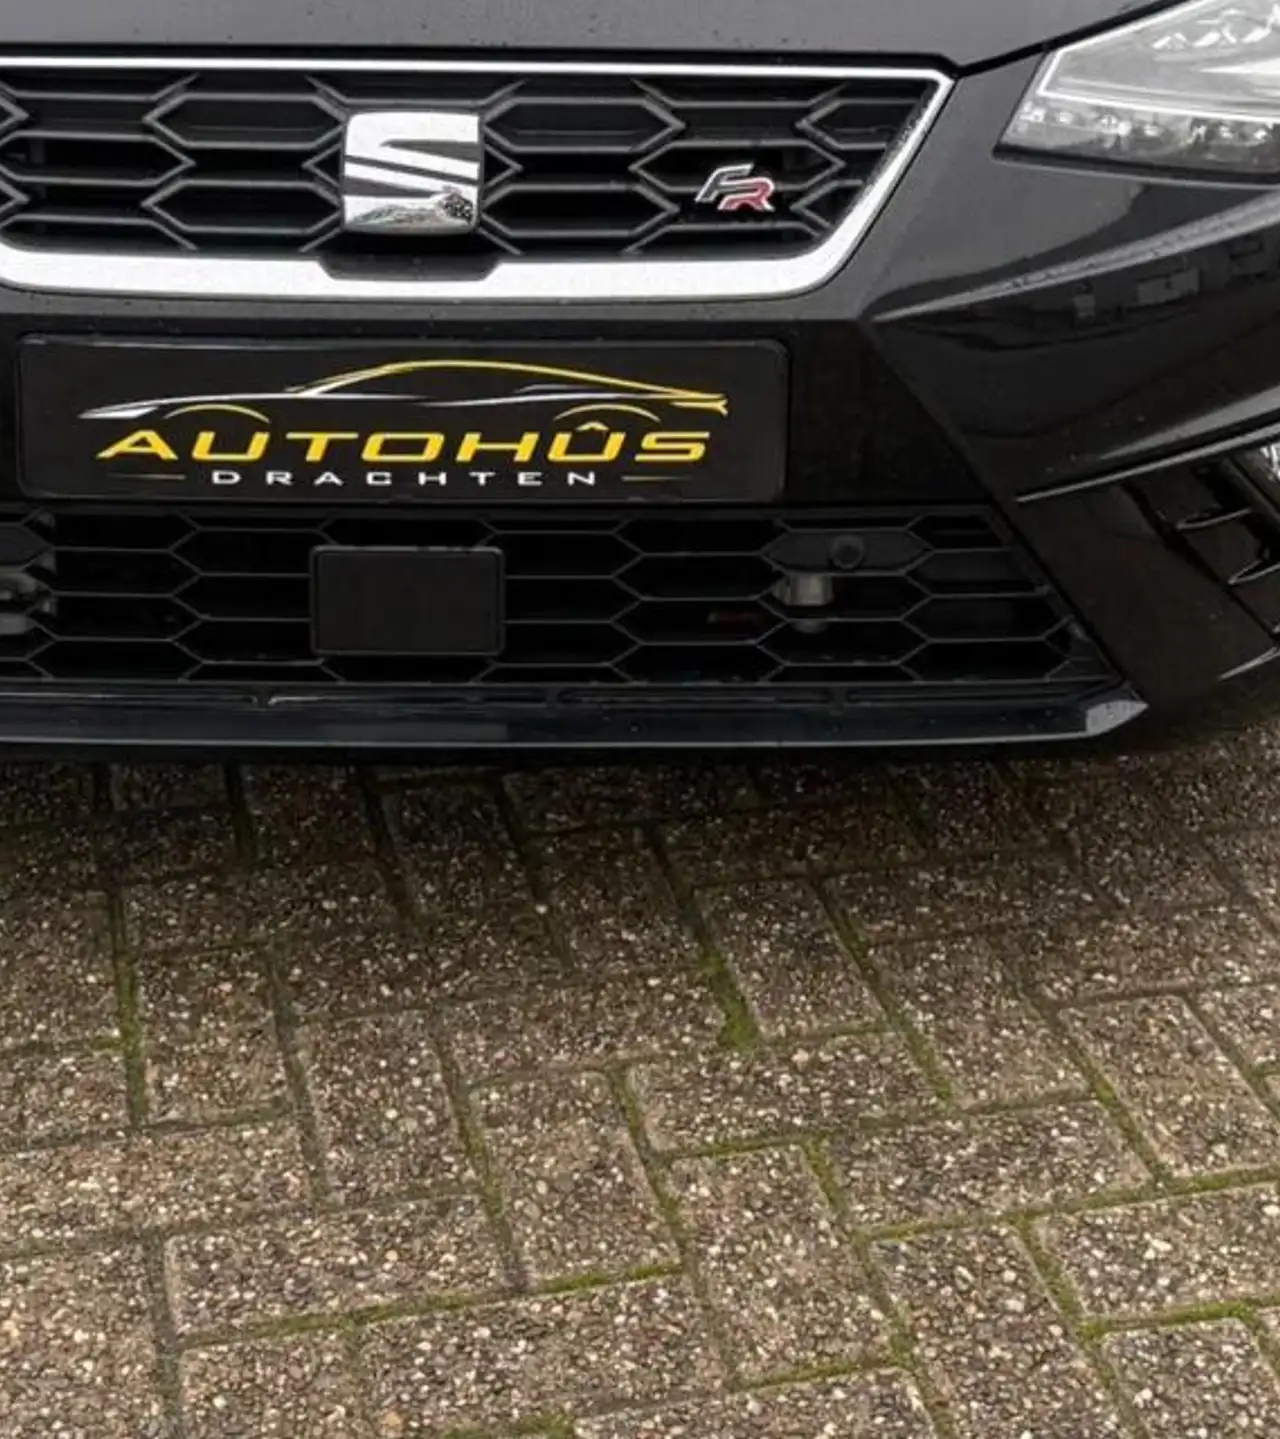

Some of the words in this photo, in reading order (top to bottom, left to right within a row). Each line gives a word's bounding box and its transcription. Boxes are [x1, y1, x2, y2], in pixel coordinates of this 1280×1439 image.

[694, 163, 775, 212] FR
[95, 421, 710, 463] AUTOHÛS
[211, 470, 597, 487] DRACHTEN
